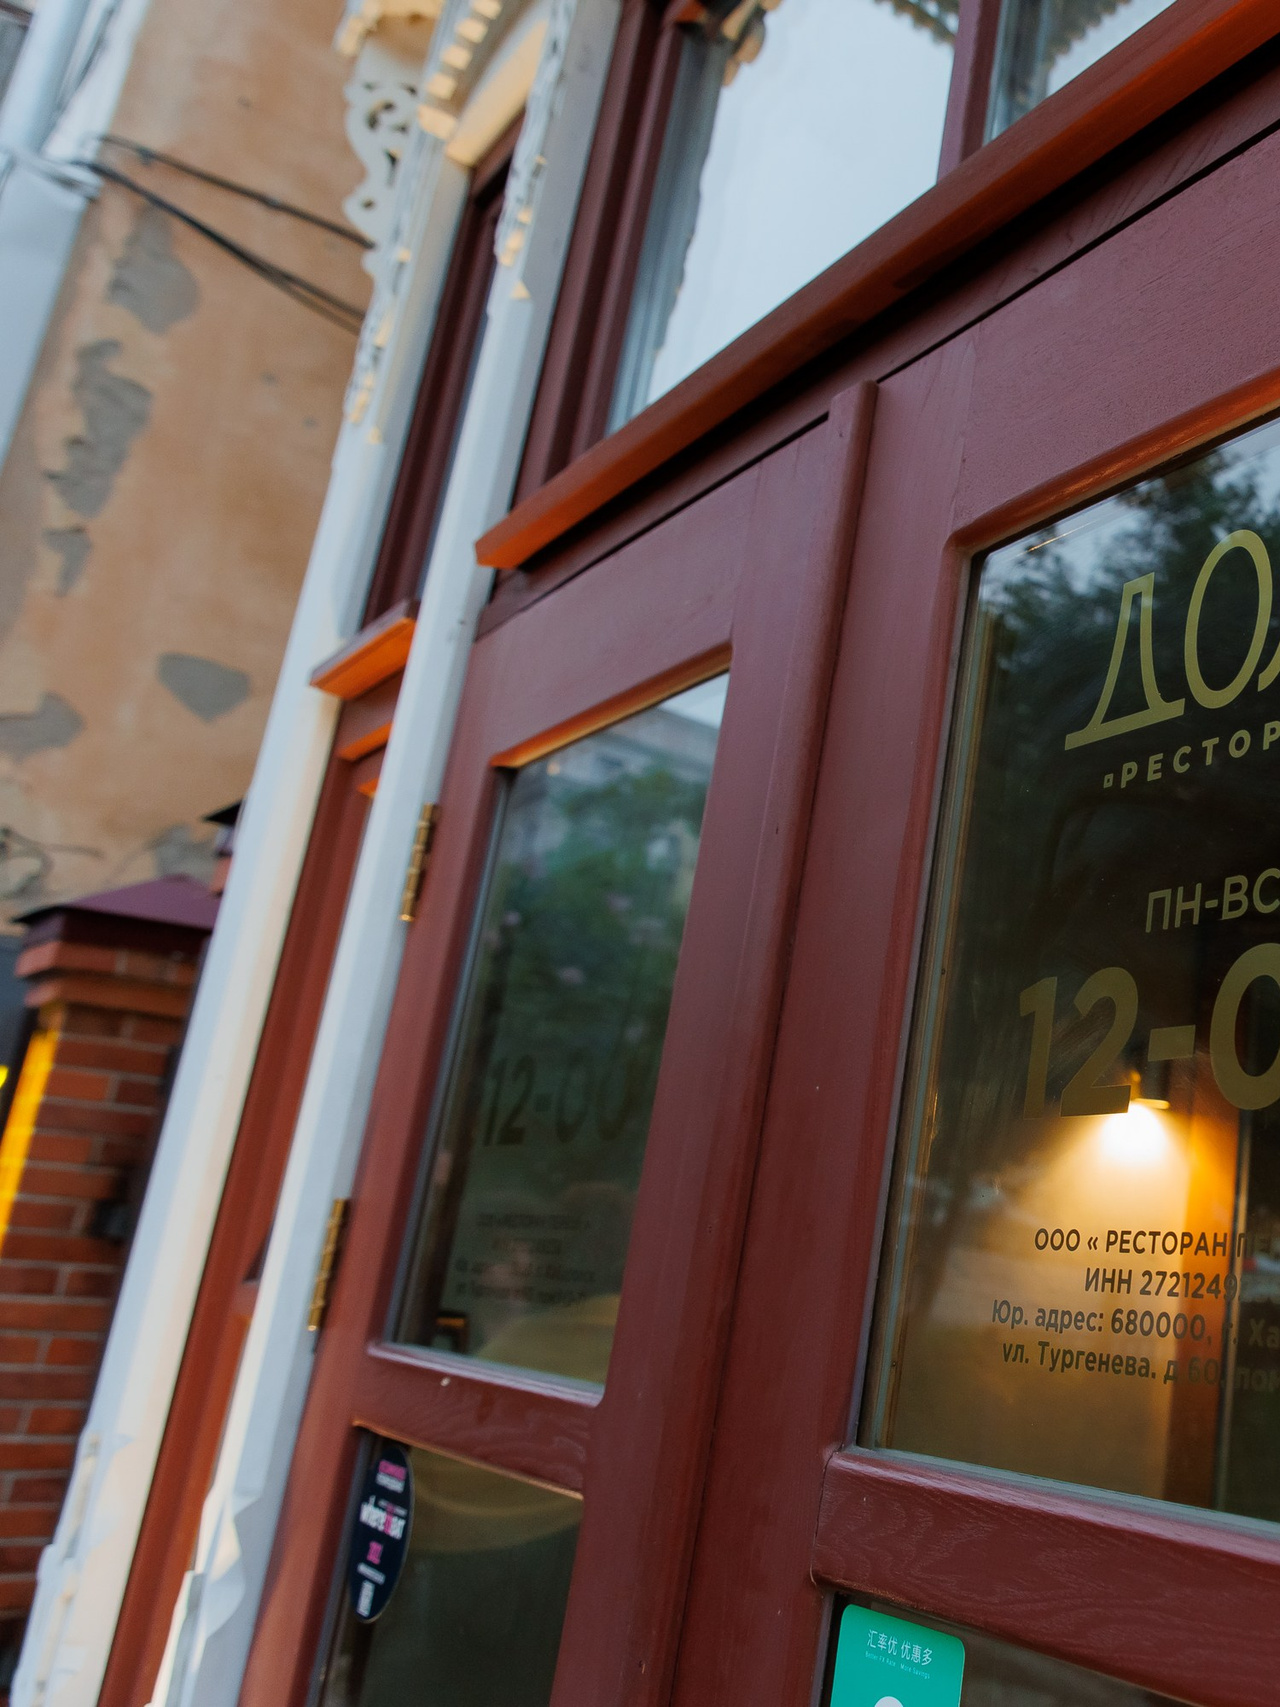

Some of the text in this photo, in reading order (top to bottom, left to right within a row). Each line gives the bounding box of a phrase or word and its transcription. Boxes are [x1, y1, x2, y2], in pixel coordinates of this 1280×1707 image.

[1033, 1228, 1081, 1252] ООО
[1105, 1229, 1228, 1257] РЕСТОРАН
[1084, 1267, 1133, 1295] ИНН
[991, 1299, 1029, 1330] Юр.
[1034, 1307, 1104, 1335] адрес:
[1111, 1308, 1213, 1346] 680000,
